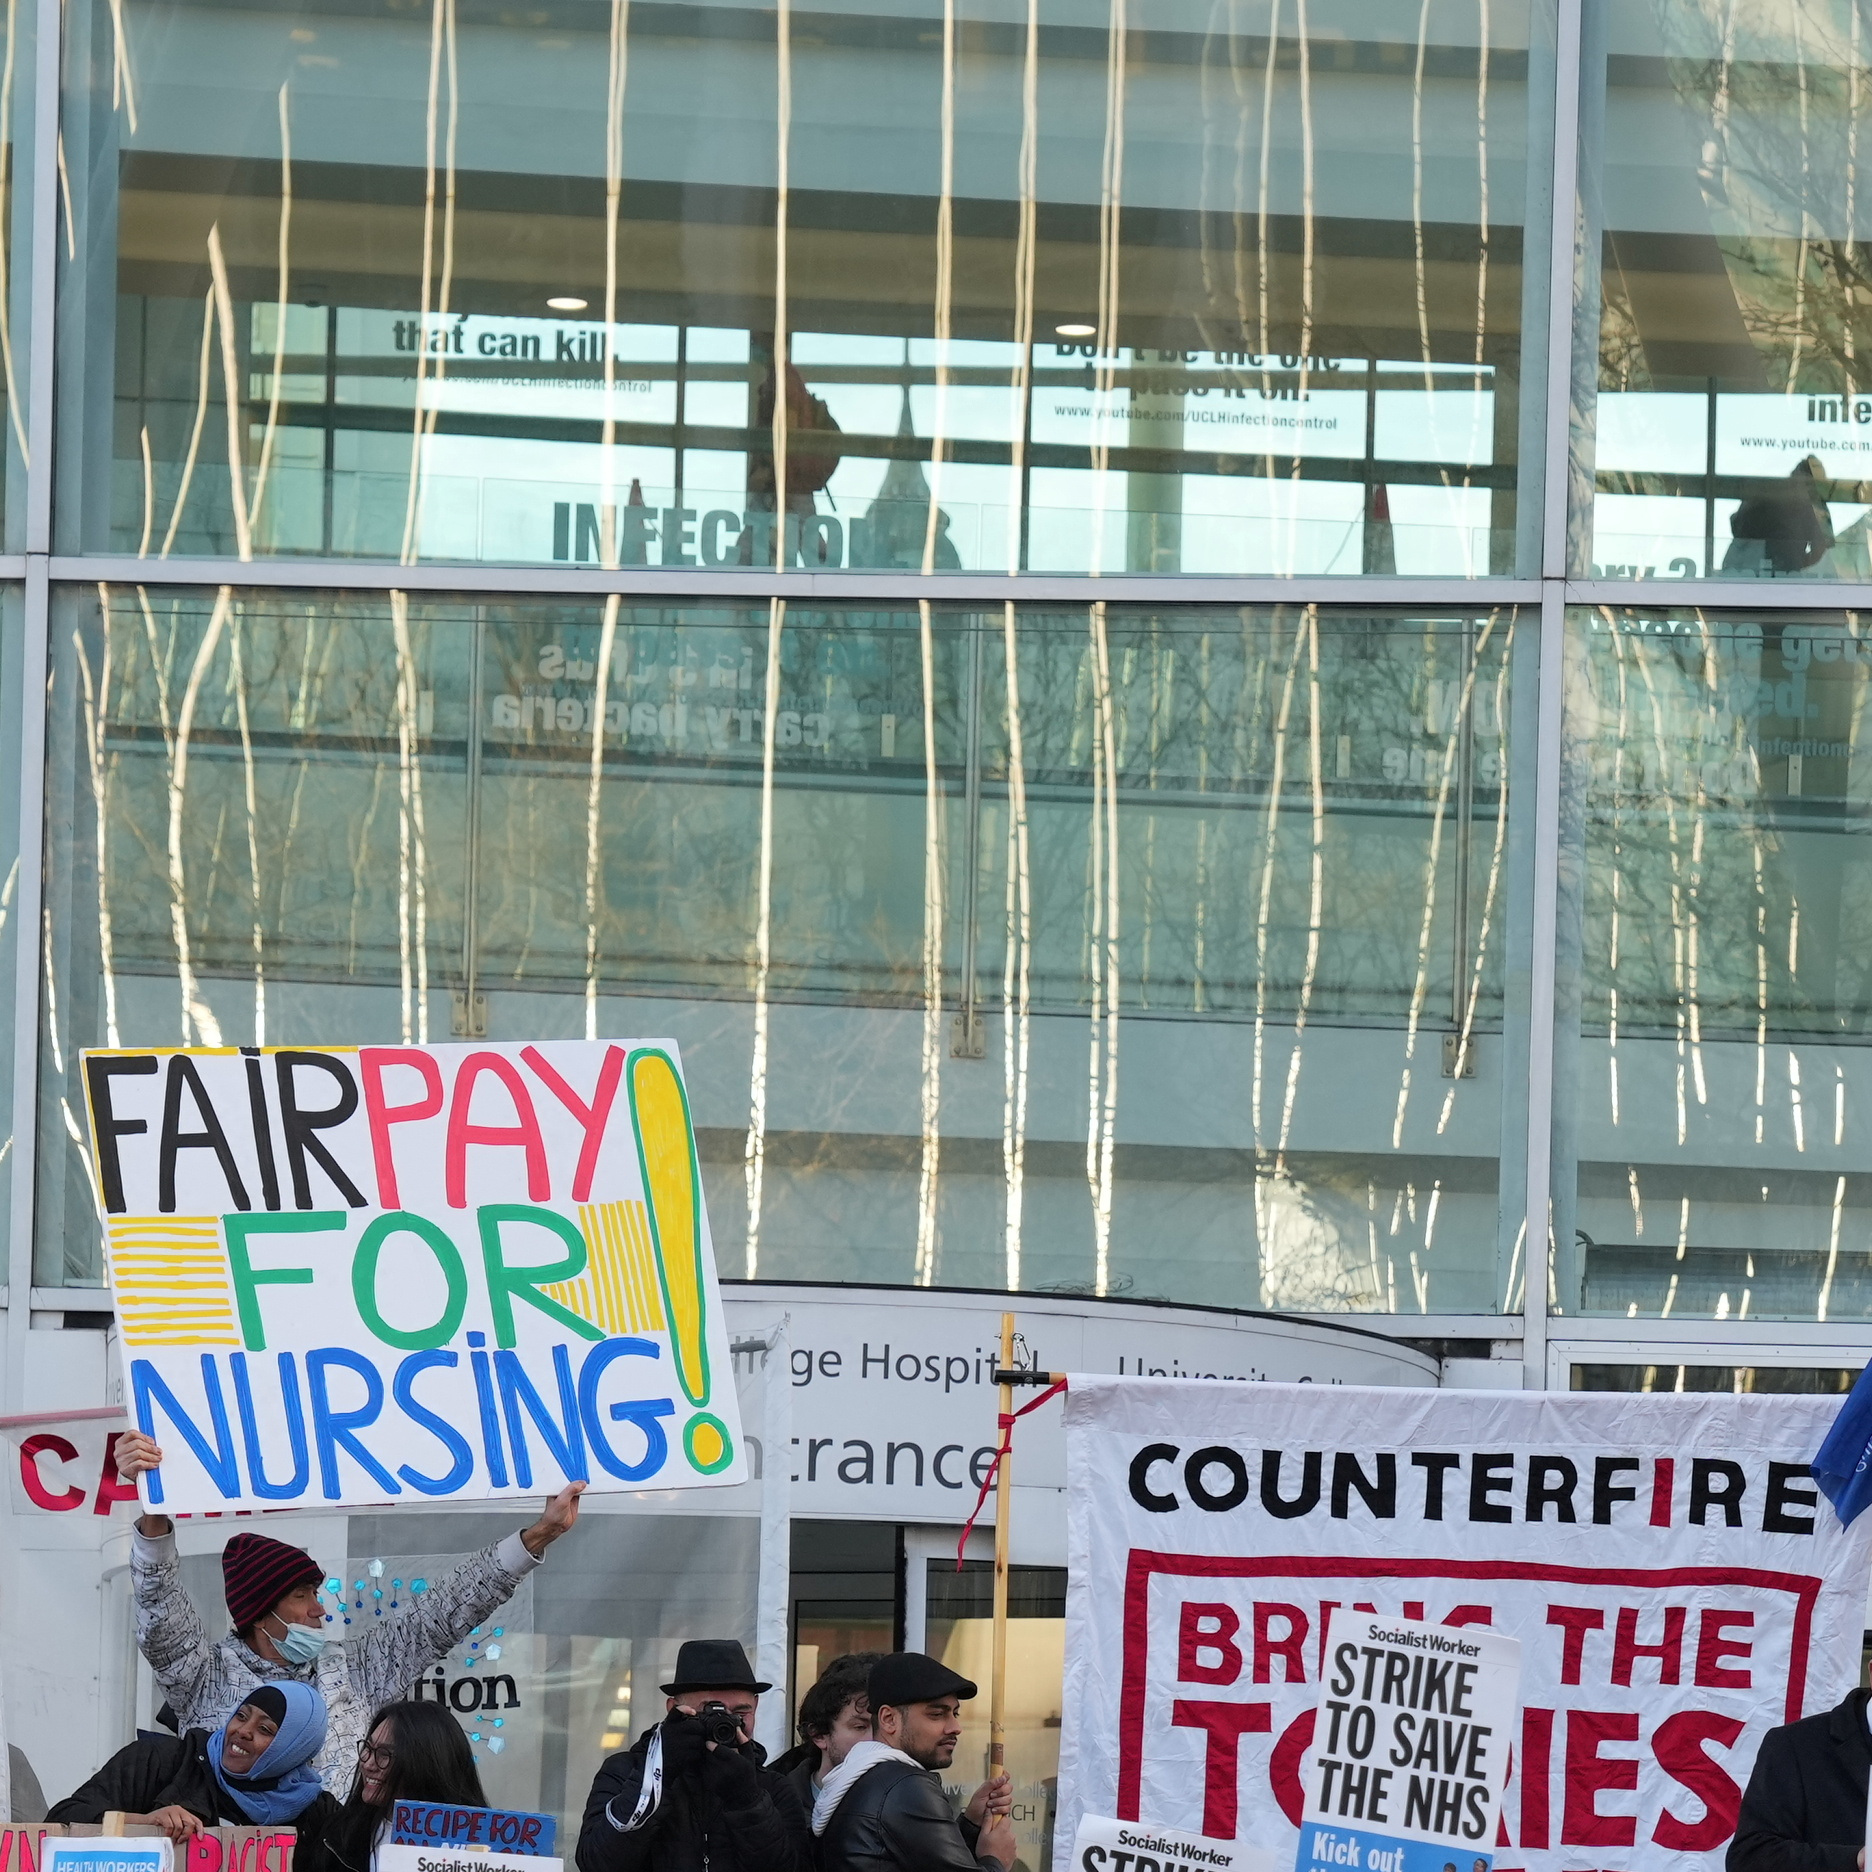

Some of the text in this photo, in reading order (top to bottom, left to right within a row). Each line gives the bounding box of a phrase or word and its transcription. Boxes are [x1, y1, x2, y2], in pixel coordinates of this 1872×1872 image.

[394, 319, 619, 363] that can kill.
[85, 1045, 627, 1213] FAIR PAY
[220, 1204, 606, 1351] FOR
[1129, 1443, 1817, 1536] COUNTERFIRE
[1330, 1642, 1478, 1718] STRIKE
[1545, 1606, 1753, 1689] THE
[1326, 1700, 1492, 1780] TO SAVE
[395, 1806, 486, 1841] RECIPE
[489, 1814, 542, 1848] FOR
[1317, 1758, 1490, 1840] THE NHS
